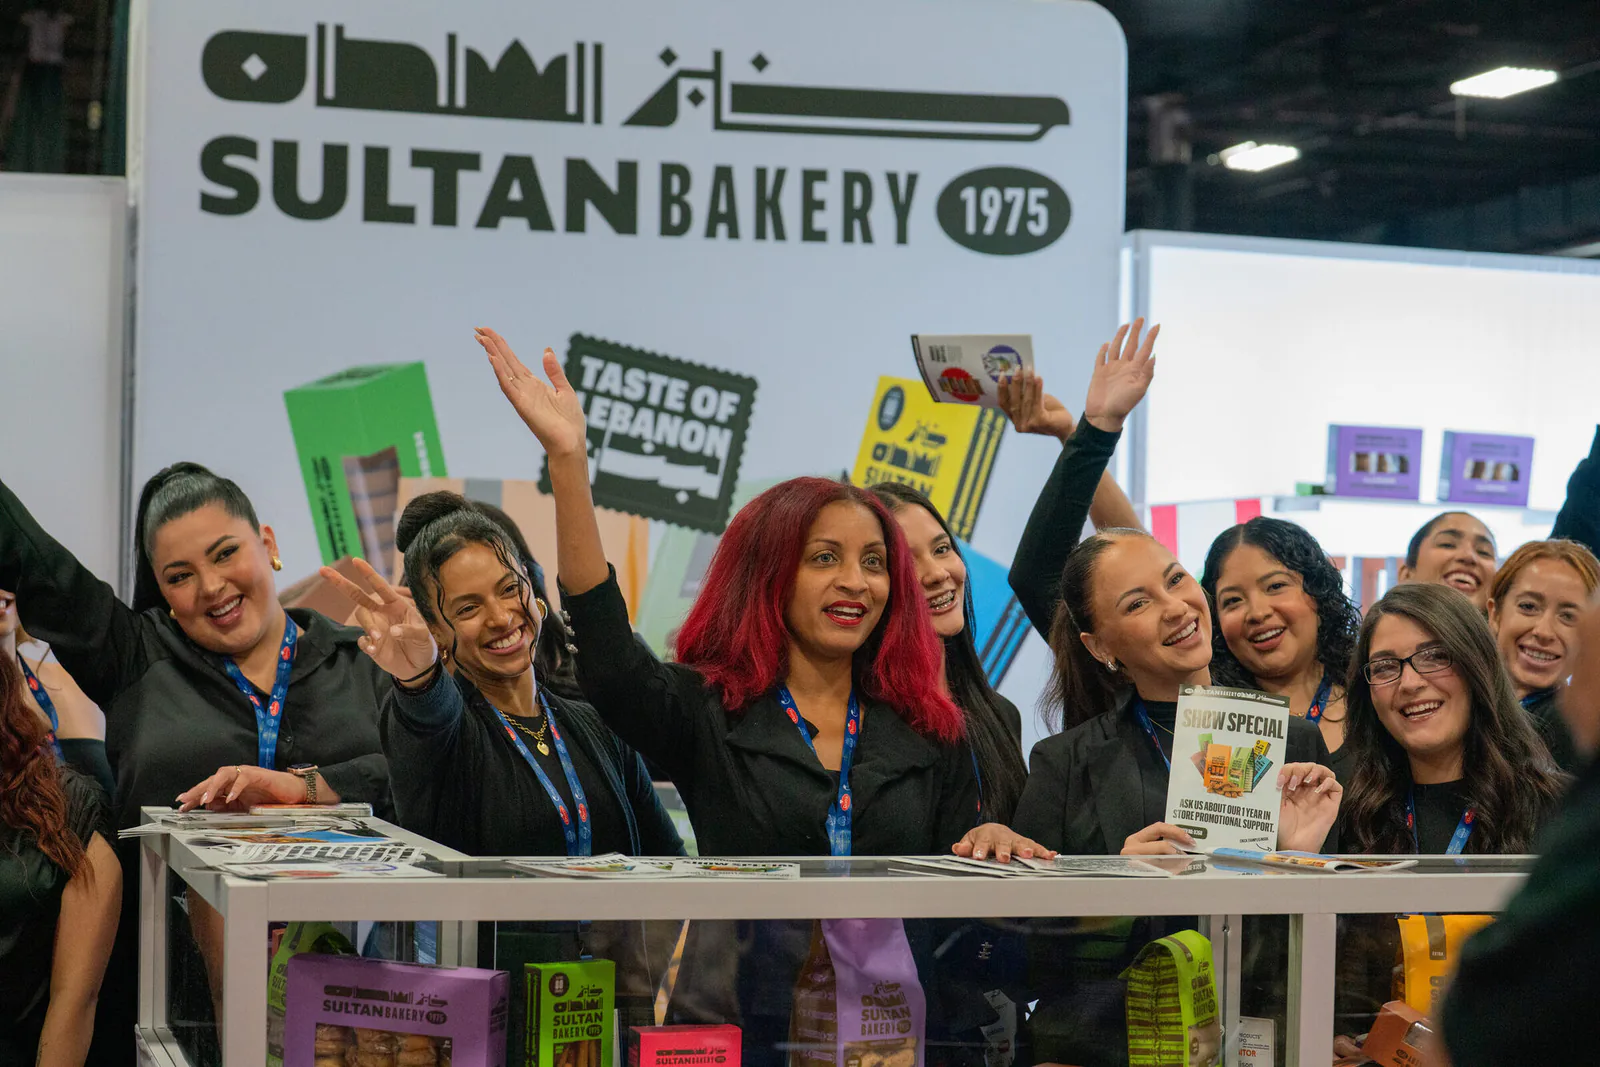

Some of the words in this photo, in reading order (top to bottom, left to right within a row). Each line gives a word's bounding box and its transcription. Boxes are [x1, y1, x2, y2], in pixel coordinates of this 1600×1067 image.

[199, 135, 638, 236] SULTAN
[659, 162, 919, 245] BAKERY
[961, 186, 1049, 236] 1975
[580, 354, 690, 413] TASTE
[690, 385, 741, 424] OF
[1182, 708, 1226, 732] SHOW
[1226, 712, 1285, 740] SPECIAL
[1179, 798, 1194, 809] ASK
[1194, 800, 1203, 811] US
[1204, 801, 1227, 813] ABOUT
[1227, 804, 1241, 816] OUR
[1242, 807, 1245, 817] 1
[1245, 807, 1263, 820] YEAR
[1263, 810, 1271, 820] IN
[1172, 809, 1195, 821] STORE
[1195, 811, 1242, 828] PROMOTIONAL
[1242, 818, 1275, 833] SUPPORT.
[322, 999, 384, 1018] SULTAN
[384, 1006, 426, 1022] BAKERY
[553, 1012, 603, 1027] SULTAN
[861, 1006, 912, 1021] SULTAN
[552, 1026, 586, 1039] BAKERY
[861, 1022, 896, 1036] BAKERY
[655, 1056, 692, 1065] SULTAN
